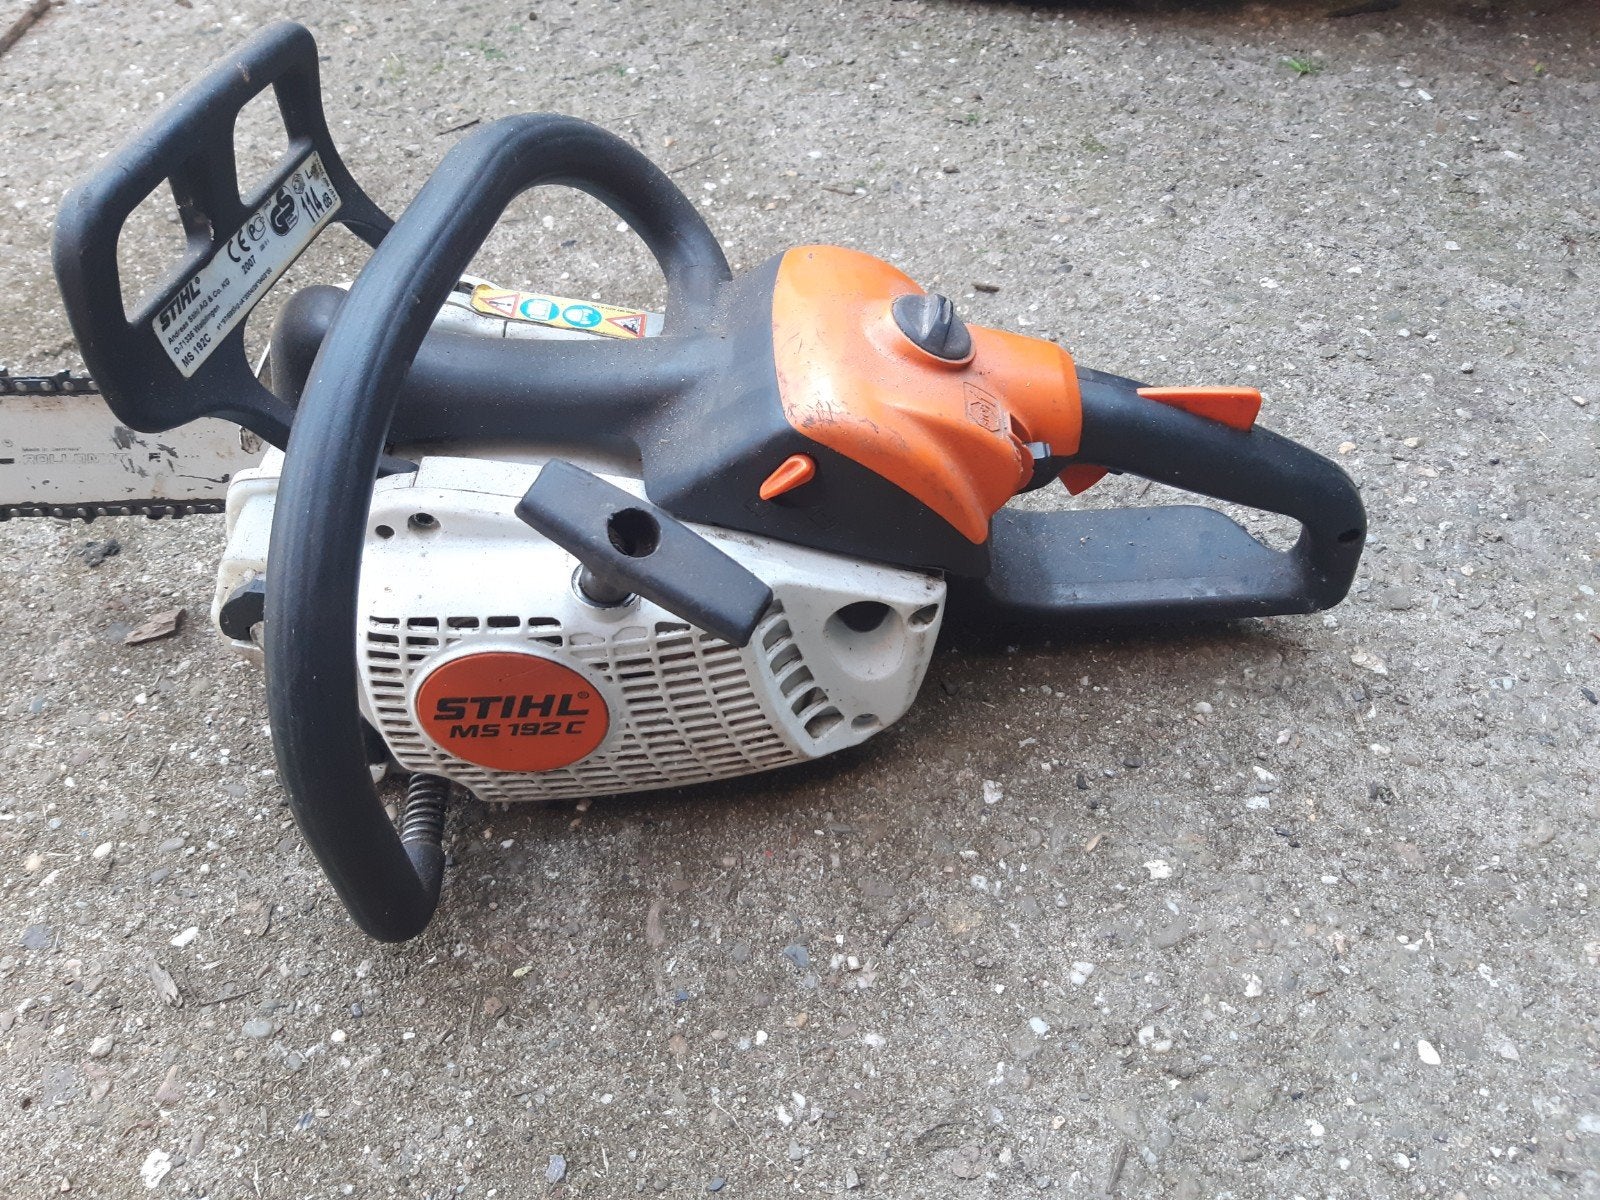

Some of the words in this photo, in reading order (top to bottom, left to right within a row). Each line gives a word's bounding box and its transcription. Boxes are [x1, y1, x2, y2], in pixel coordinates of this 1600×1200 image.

[300, 186, 323, 223] 114
[241, 255, 257, 275] 2007
[168, 321, 189, 344] Andreas
[199, 299, 208, 312] AG
[208, 295, 214, 303] &
[212, 288, 222, 298] Co.
[221, 277, 231, 289] KG
[181, 352, 195, 368] MS
[193, 333, 212, 354] 192C
[434, 694, 589, 720] STIHL
[449, 723, 500, 738] MS
